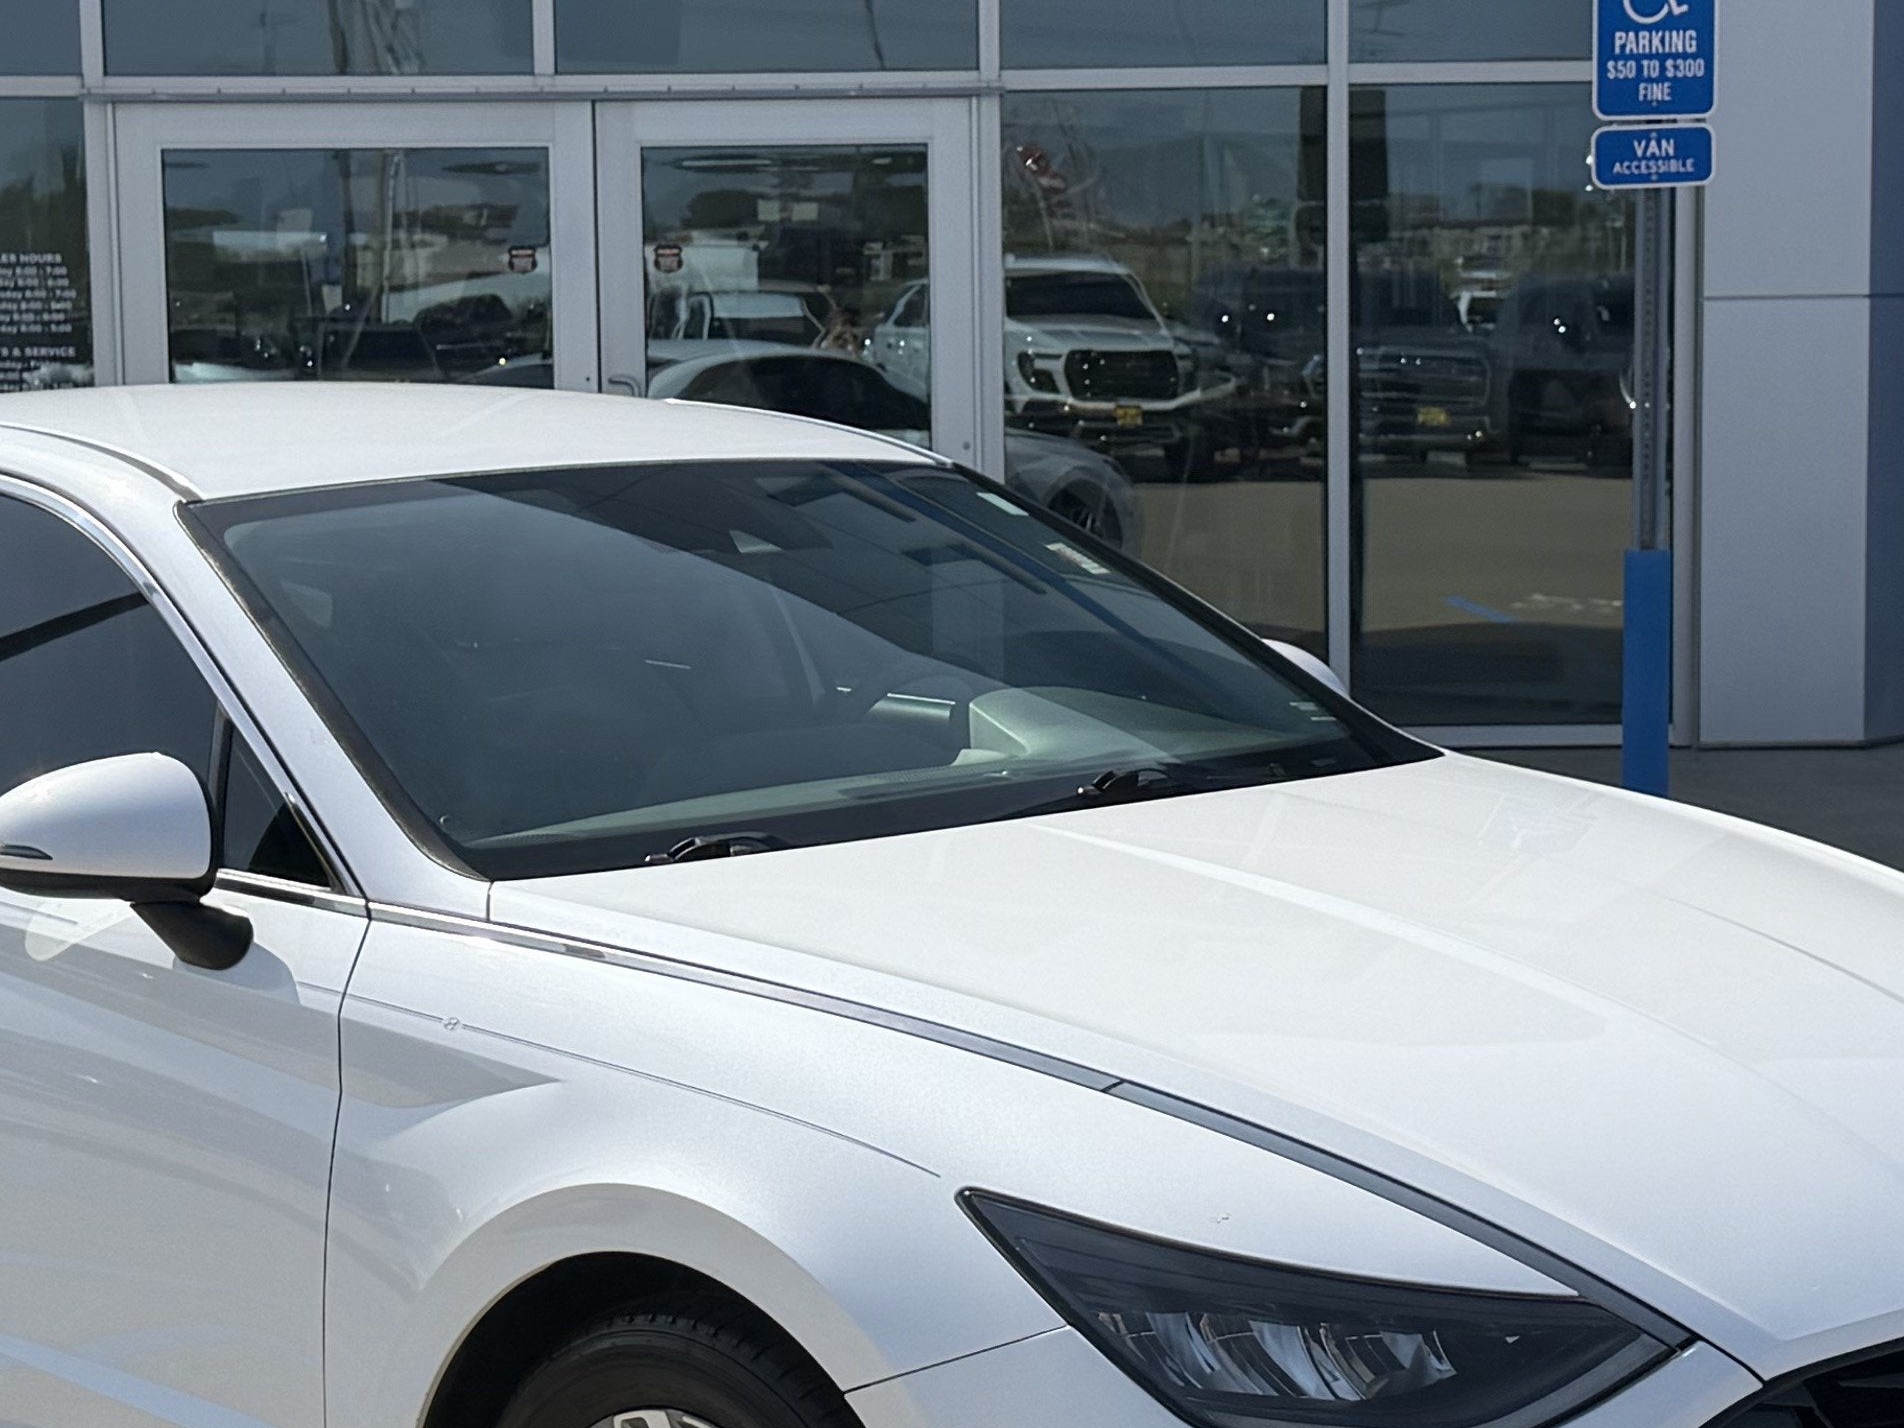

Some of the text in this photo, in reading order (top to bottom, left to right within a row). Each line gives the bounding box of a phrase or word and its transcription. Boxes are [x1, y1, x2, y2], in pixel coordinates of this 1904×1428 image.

[1614, 29, 1697, 54] PARKING
[1606, 58, 1705, 79] $50 TO $300
[1638, 82, 1671, 102] FINE
[1633, 138, 1675, 157] VAN
[1612, 158, 1695, 174] ACCESSIBLE
